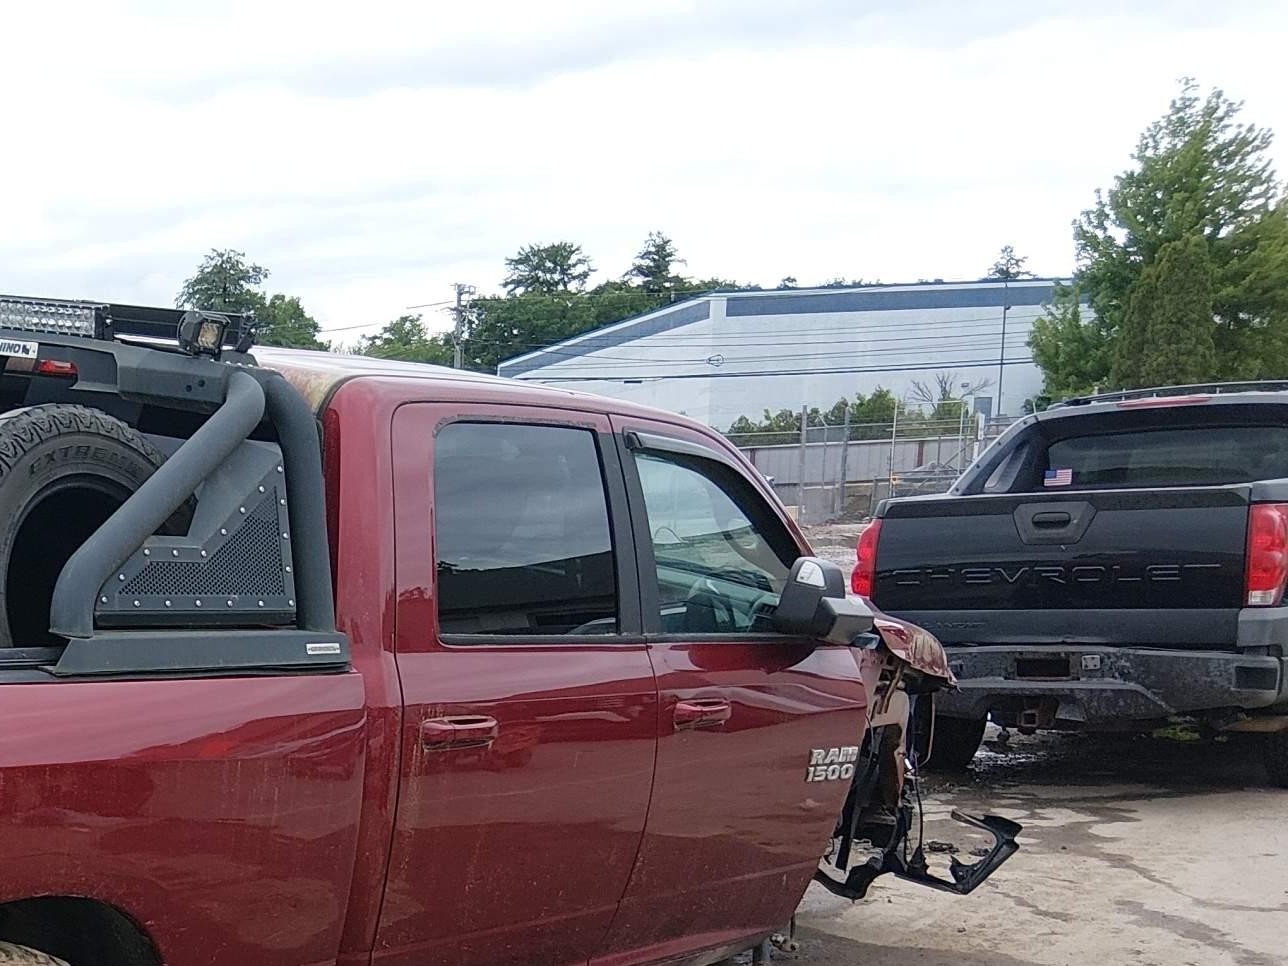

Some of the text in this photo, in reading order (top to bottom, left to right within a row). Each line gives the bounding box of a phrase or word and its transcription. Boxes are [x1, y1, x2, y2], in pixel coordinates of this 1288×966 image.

[891, 562, 1222, 586] CHEVROLET
[809, 745, 859, 765] RAM
[806, 763, 854, 783] 1500
